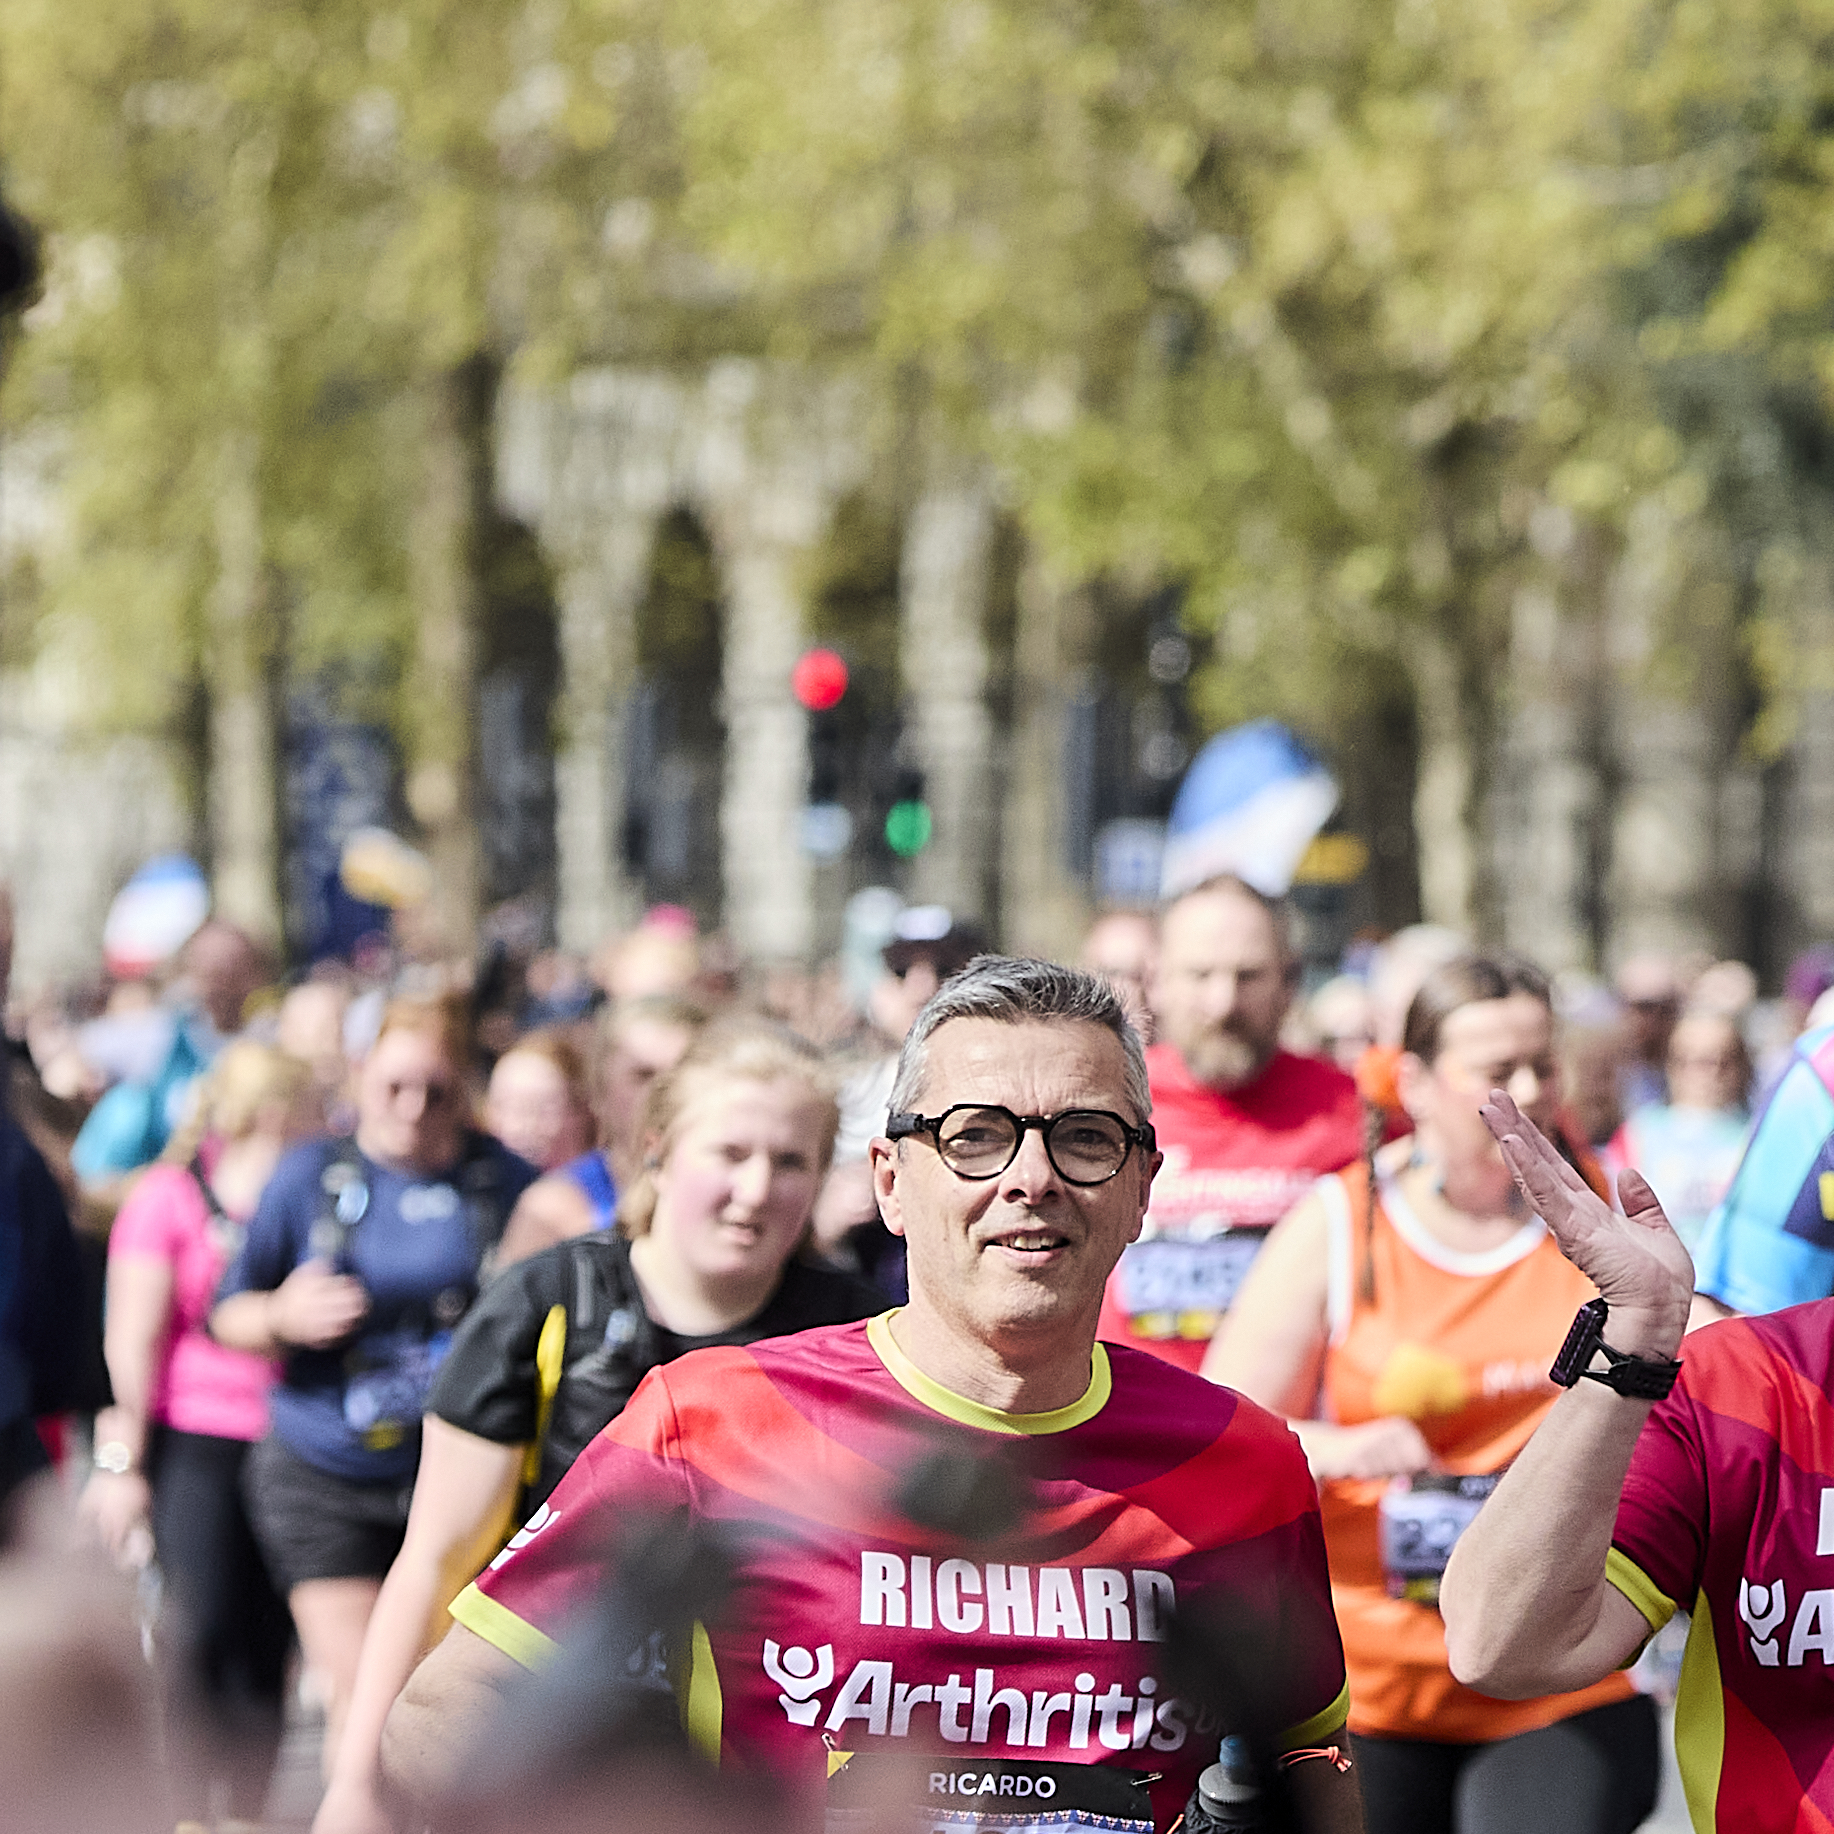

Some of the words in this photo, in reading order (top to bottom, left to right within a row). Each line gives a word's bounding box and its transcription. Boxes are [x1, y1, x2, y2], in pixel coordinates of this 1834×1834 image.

[859, 1550, 1176, 1643] RICHARD
[824, 1659, 1192, 1751] Arthritis
[928, 1772, 1056, 1799] RICARDO
